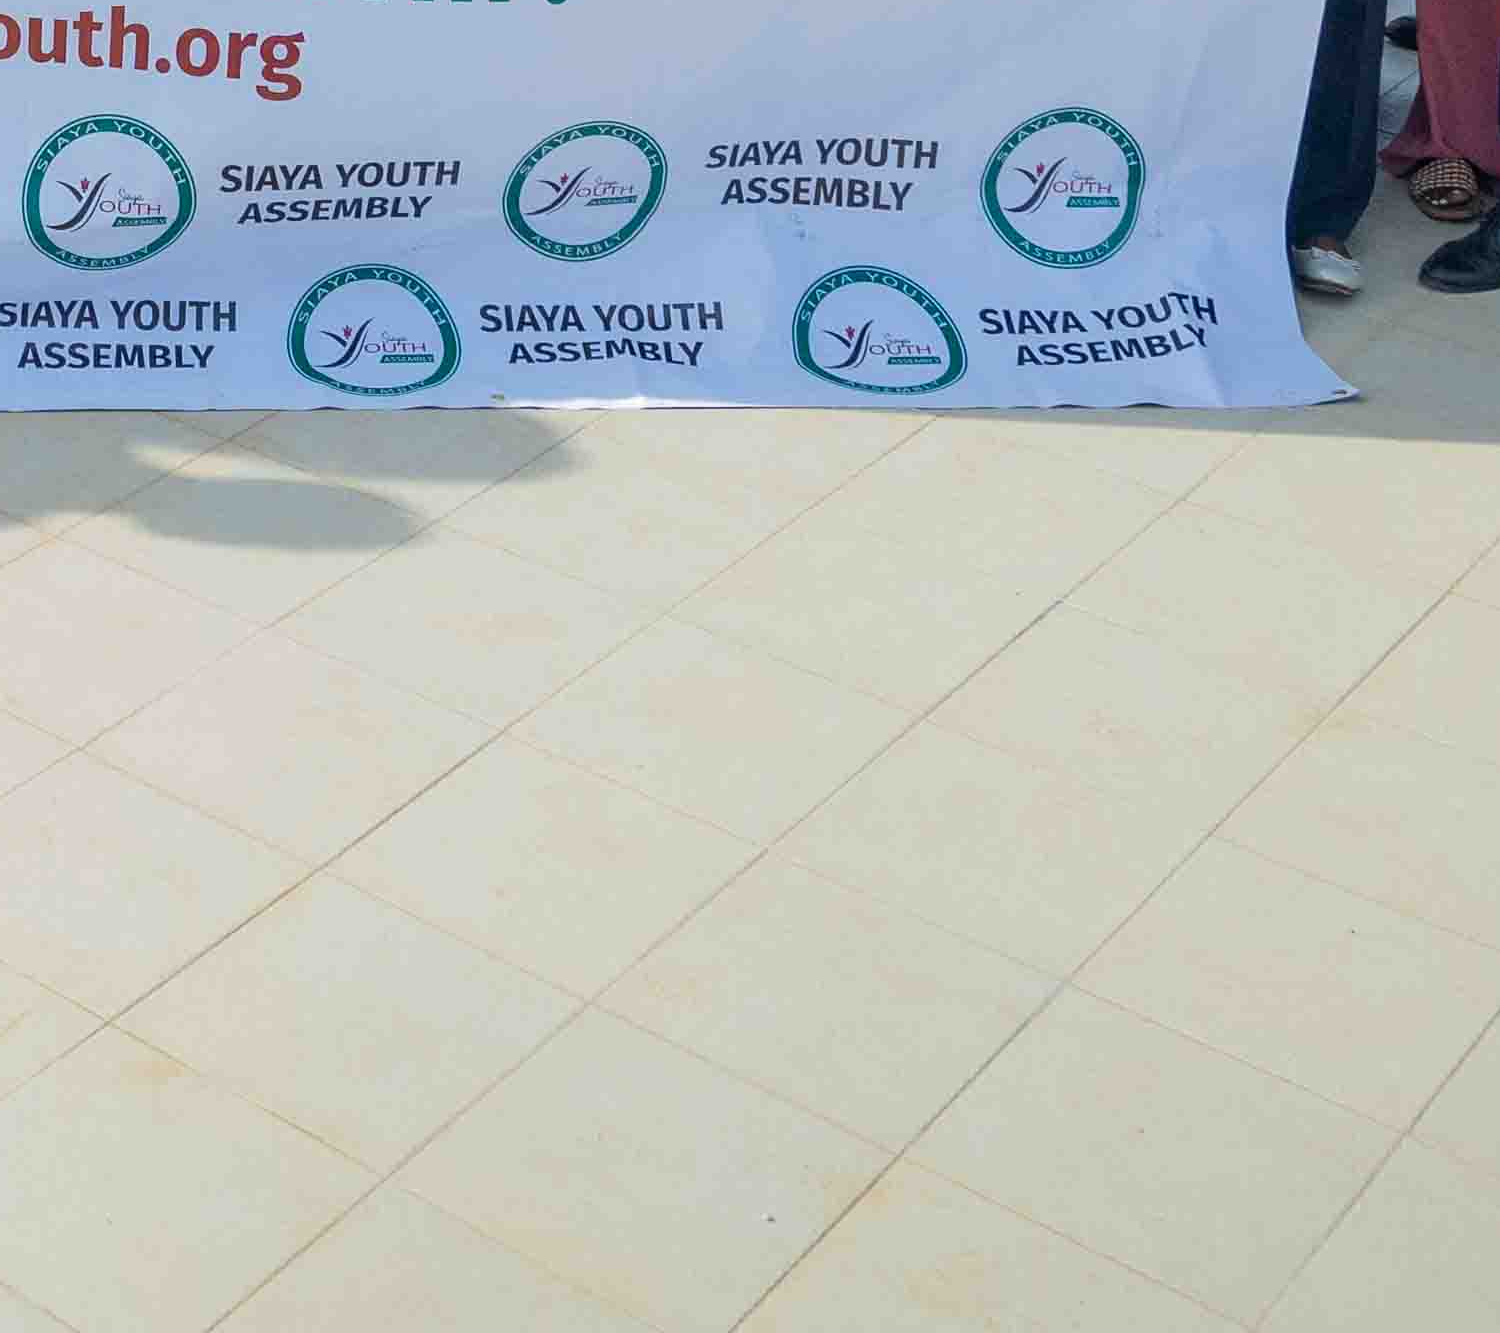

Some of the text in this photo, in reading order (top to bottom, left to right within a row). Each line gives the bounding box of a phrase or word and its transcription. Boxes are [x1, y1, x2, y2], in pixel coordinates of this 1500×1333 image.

[35, 121, 187, 185] SIAYA YOUTH
[518, 126, 660, 176] SIAYA YOUTH
[705, 138, 939, 169] SIAYA YOUTH
[994, 112, 1140, 167] SIAYA YOUTH
[219, 160, 461, 193] SIAYA YOUTH
[720, 176, 913, 211] ASSEMBLY
[237, 195, 433, 225] ASSEMBLY
[297, 269, 447, 326] SIAYA YOUTH
[800, 272, 948, 329] SIAYA YOUTH
[979, 291, 1218, 335] SIAYA YOUTH
[109, 299, 237, 332] YOUTH
[479, 301, 724, 333] SIAYA YOUTH
[17, 341, 215, 369] ASSEMBLY
[508, 337, 704, 367] ASSEMBLY
[1017, 323, 1208, 367] ASSEMBLY
